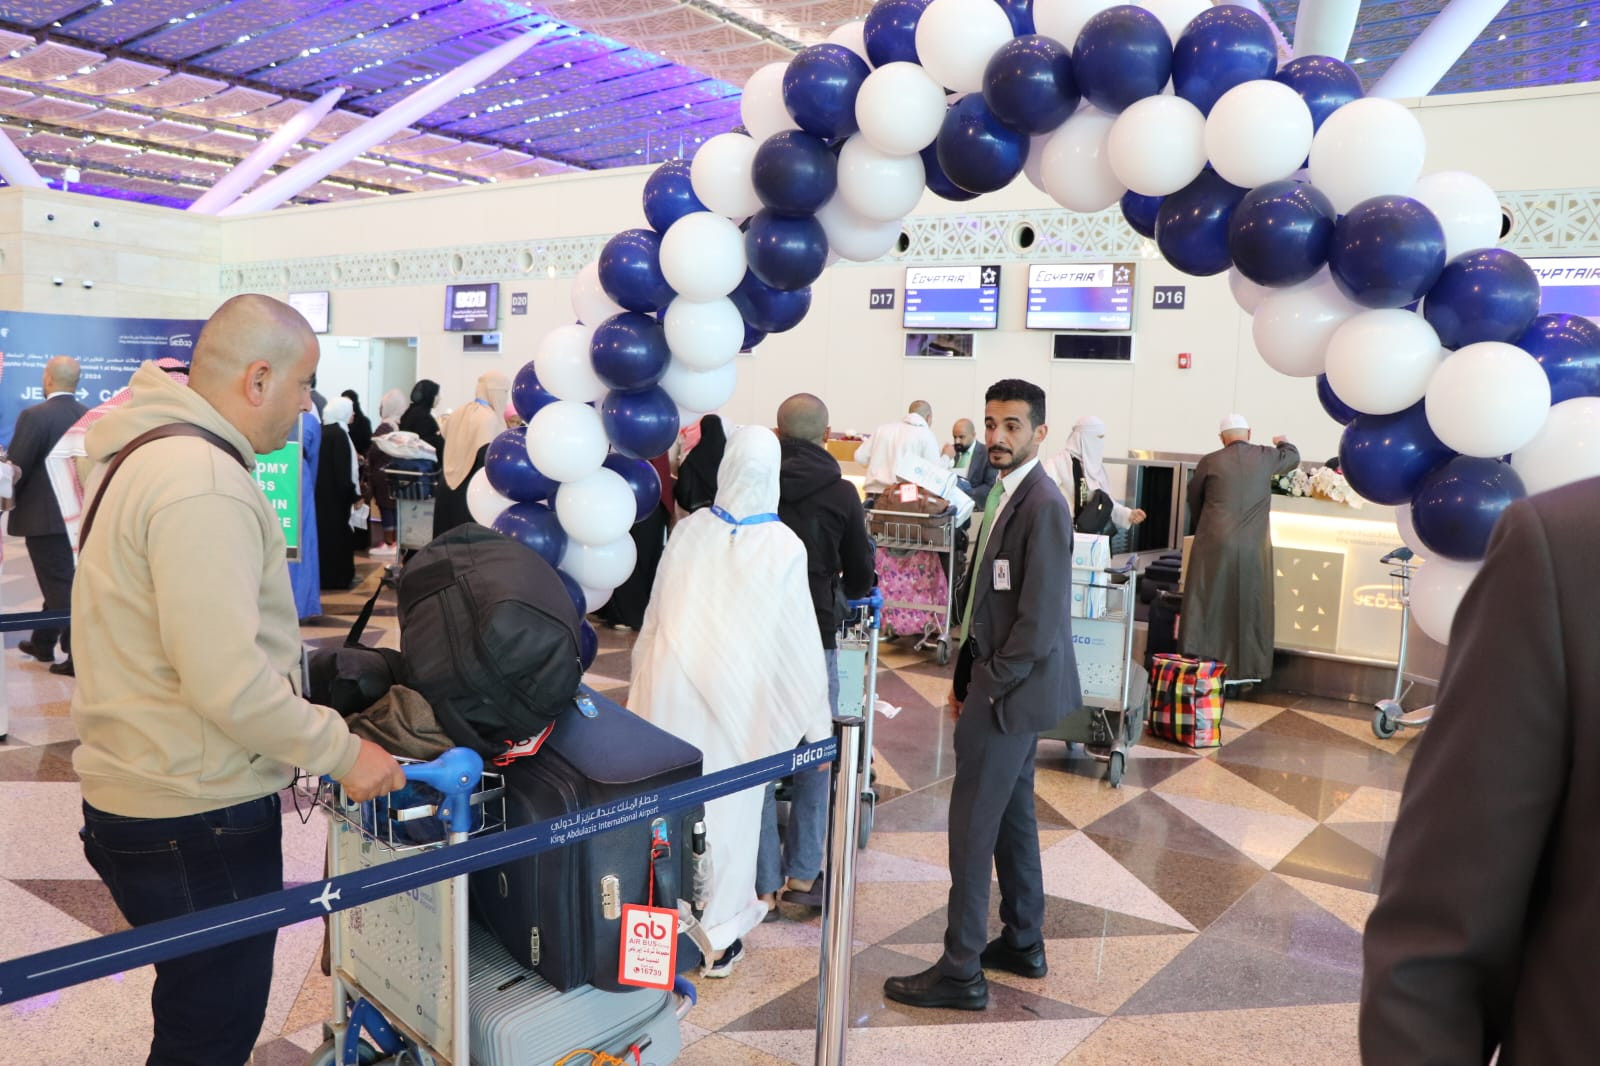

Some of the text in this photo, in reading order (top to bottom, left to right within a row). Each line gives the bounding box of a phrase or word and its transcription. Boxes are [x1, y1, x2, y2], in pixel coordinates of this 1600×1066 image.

[1035, 270, 1096, 282] EGYPTAIR
[871, 293, 893, 305] D17
[1154, 291, 1184, 304] D16
[21, 387, 44, 400] JE
[254, 462, 289, 475] OMY
[258, 480, 276, 492] SS
[1071, 634, 1091, 645] dco
[791, 747, 823, 772] jedco
[616, 797, 638, 812] الملك
[638, 793, 659, 808] مطار
[550, 813, 581, 832] الدولي
[550, 806, 660, 845] King Abdulaziz International Airport
[633, 920, 667, 941] ab
[640, 966, 663, 977] 16739
